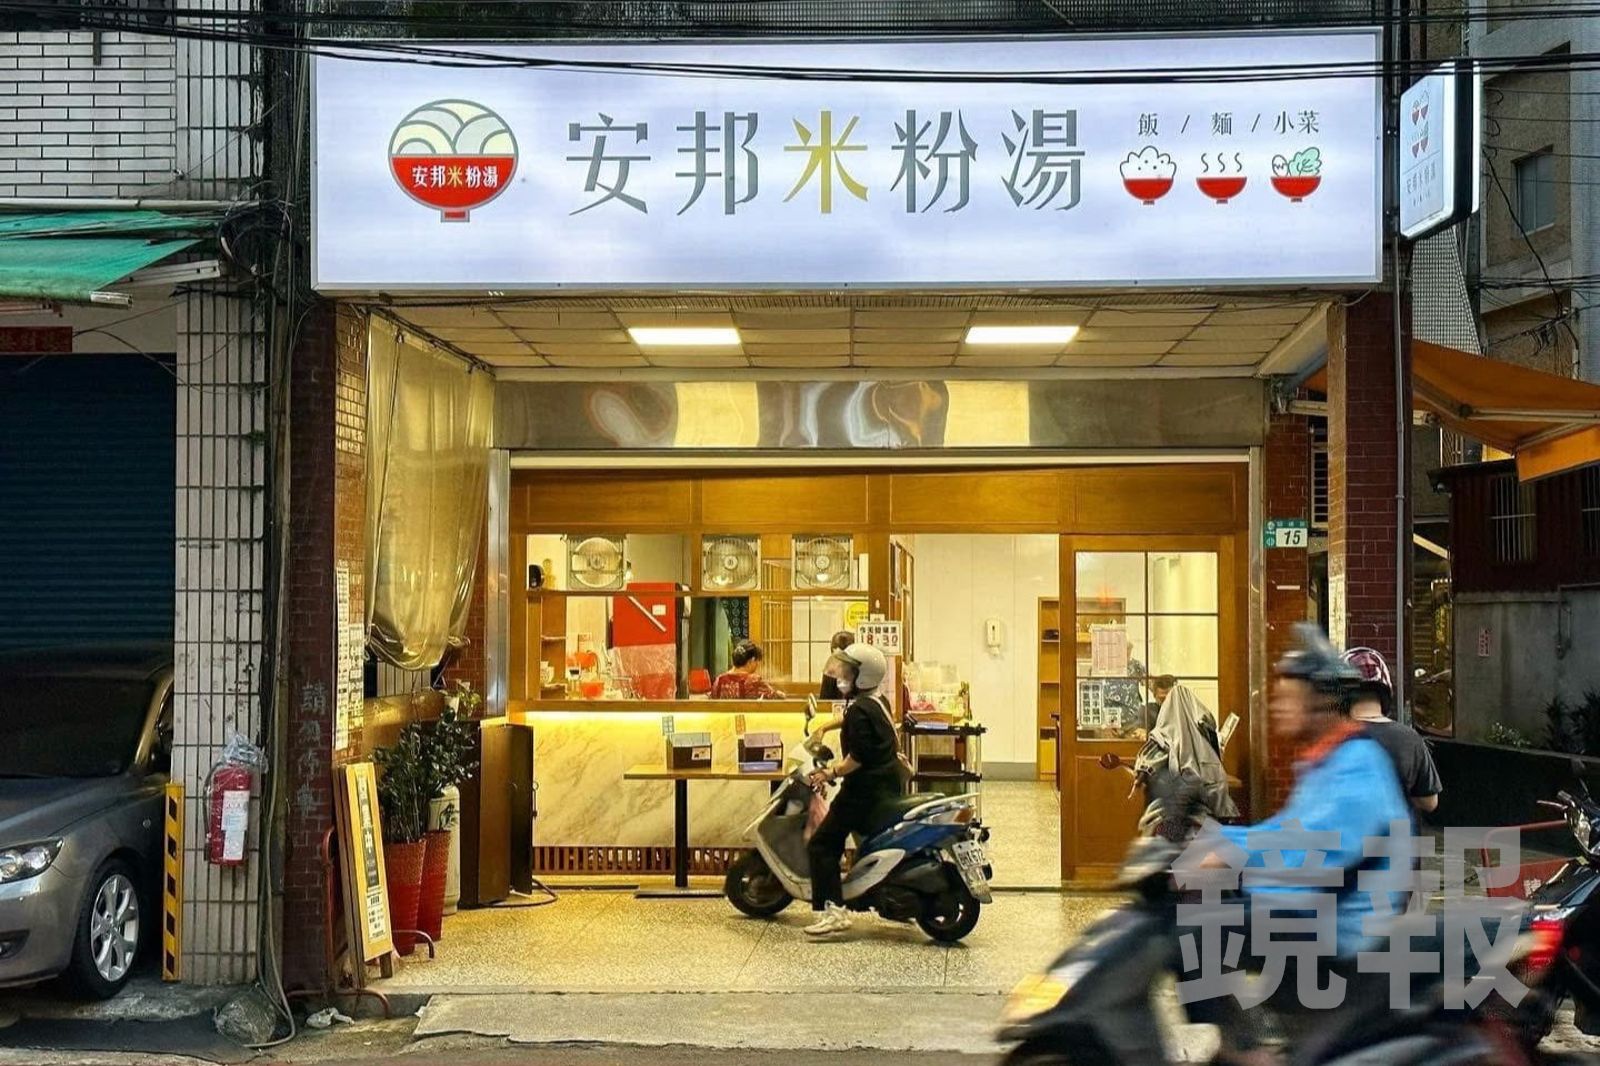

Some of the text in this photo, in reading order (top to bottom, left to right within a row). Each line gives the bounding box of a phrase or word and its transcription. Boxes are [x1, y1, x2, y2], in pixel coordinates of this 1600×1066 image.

[1137, 112, 1160, 137] 飯
[1211, 112, 1234, 136] 麵
[1274, 110, 1321, 135] 小菜
[567, 109, 1085, 216] 安邦米粉湯
[411, 165, 499, 189] 安邦米粉湯
[1284, 530, 1302, 546] 15
